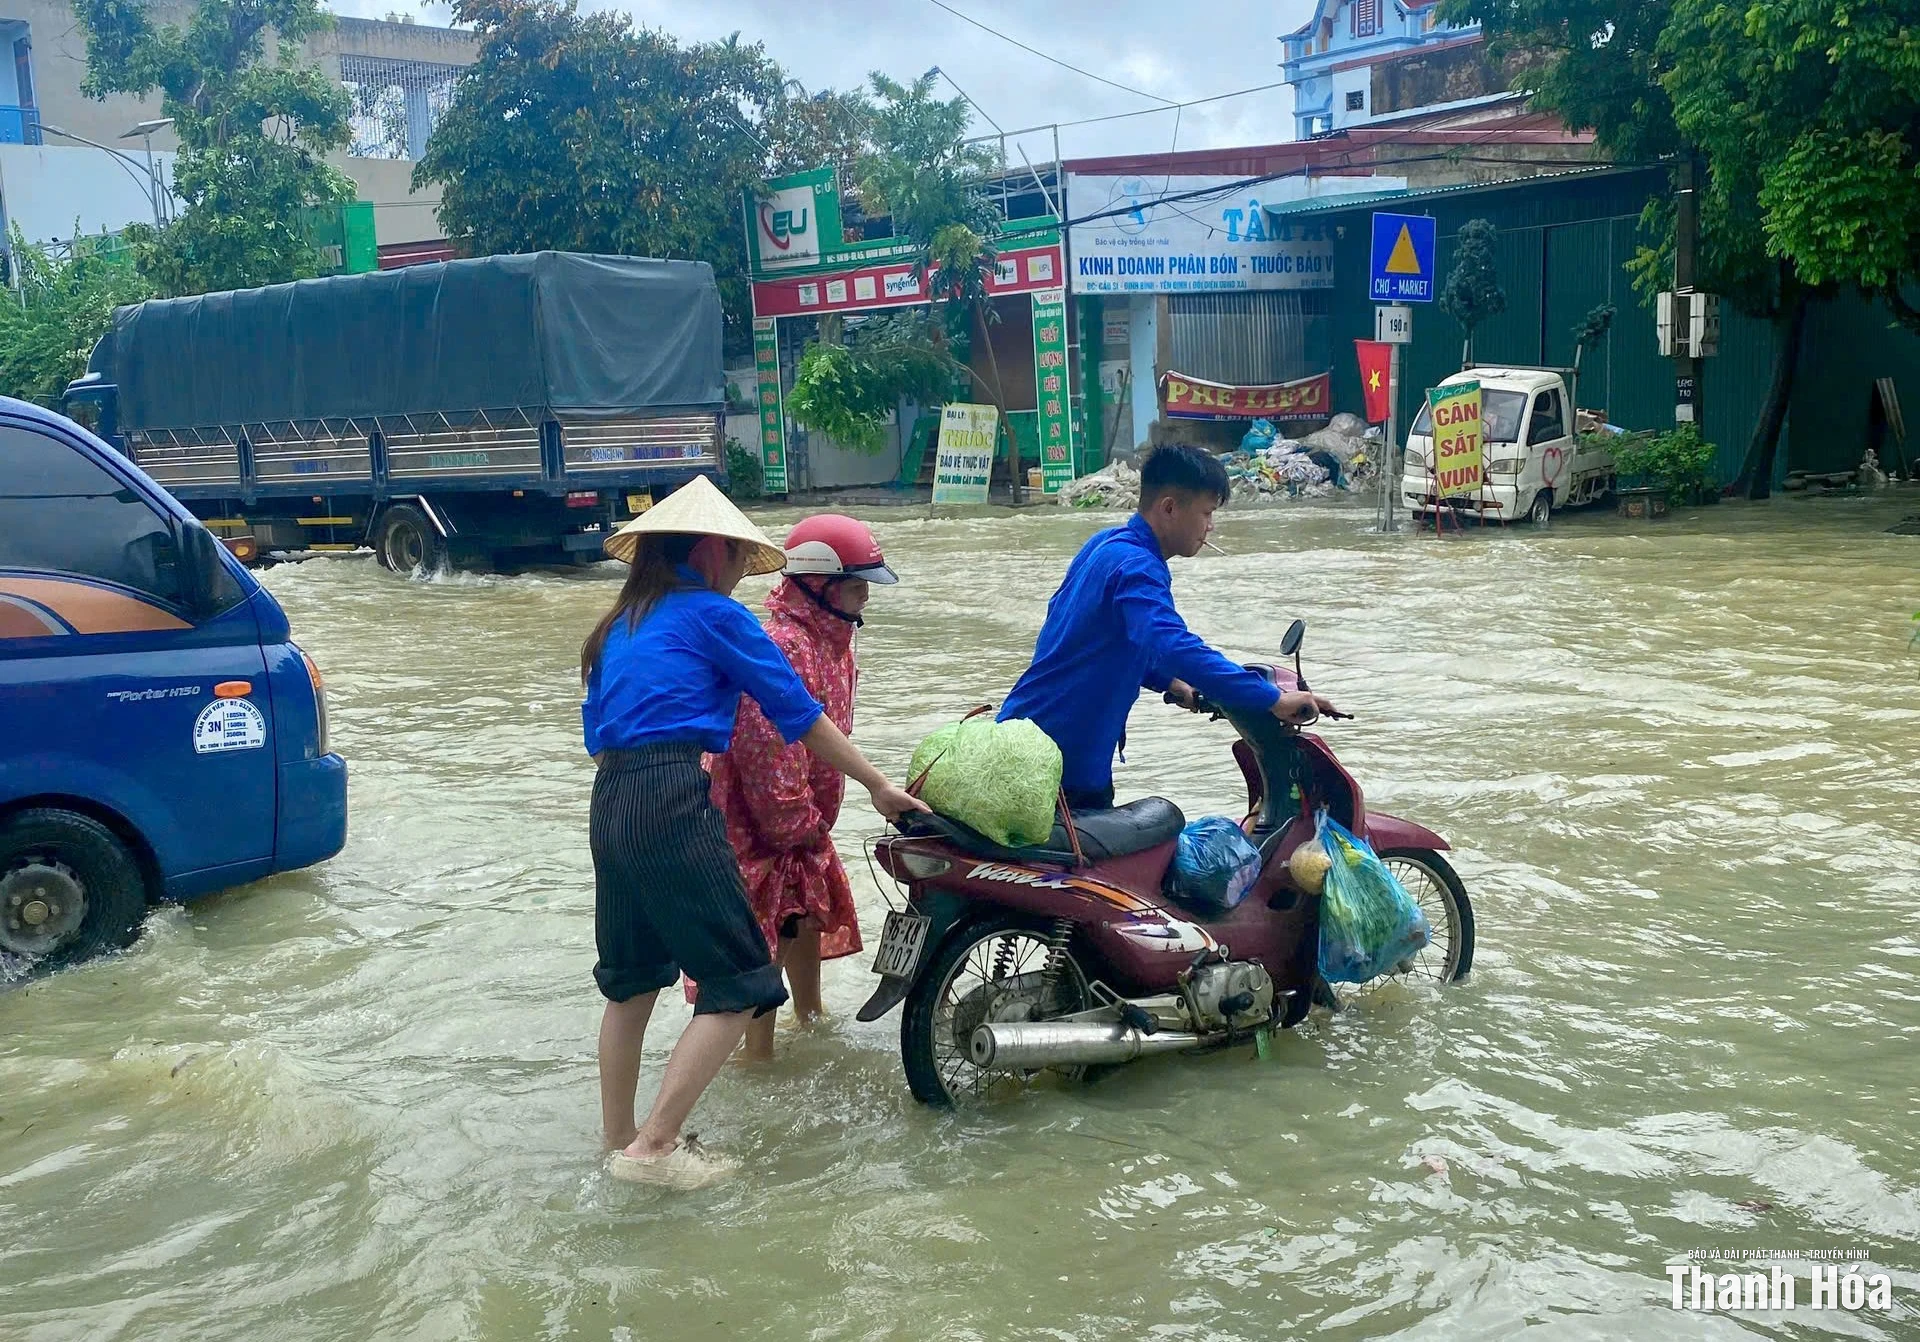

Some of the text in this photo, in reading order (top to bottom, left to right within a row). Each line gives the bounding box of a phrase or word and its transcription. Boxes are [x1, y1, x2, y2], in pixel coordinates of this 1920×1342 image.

[1223, 199, 1292, 242] TÂM
[1039, 264, 1051, 272] UPL
[1118, 256, 1164, 275] DOANH
[1169, 253, 1206, 275] PHÂN
[1210, 253, 1238, 274] BÓN
[1251, 250, 1292, 274] THUỐC
[1296, 251, 1321, 273] BẢO
[886, 277, 917, 292] syngenta
[1375, 278, 1390, 297] CHỢ
[1398, 279, 1428, 296] MARKET
[1390, 318, 1403, 332] 190
[946, 411, 956, 420] ĐẠI
[1435, 402, 1478, 426] CÂN
[944, 423, 993, 449] THUỐC
[1440, 430, 1477, 458] SẮT
[940, 450, 990, 472] BẢO VỆ THỰC VẬT
[1440, 465, 1479, 490] VỤN
[120, 688, 169, 702] Porter
[169, 686, 201, 698] H150
[208, 721, 222, 733] 3N
